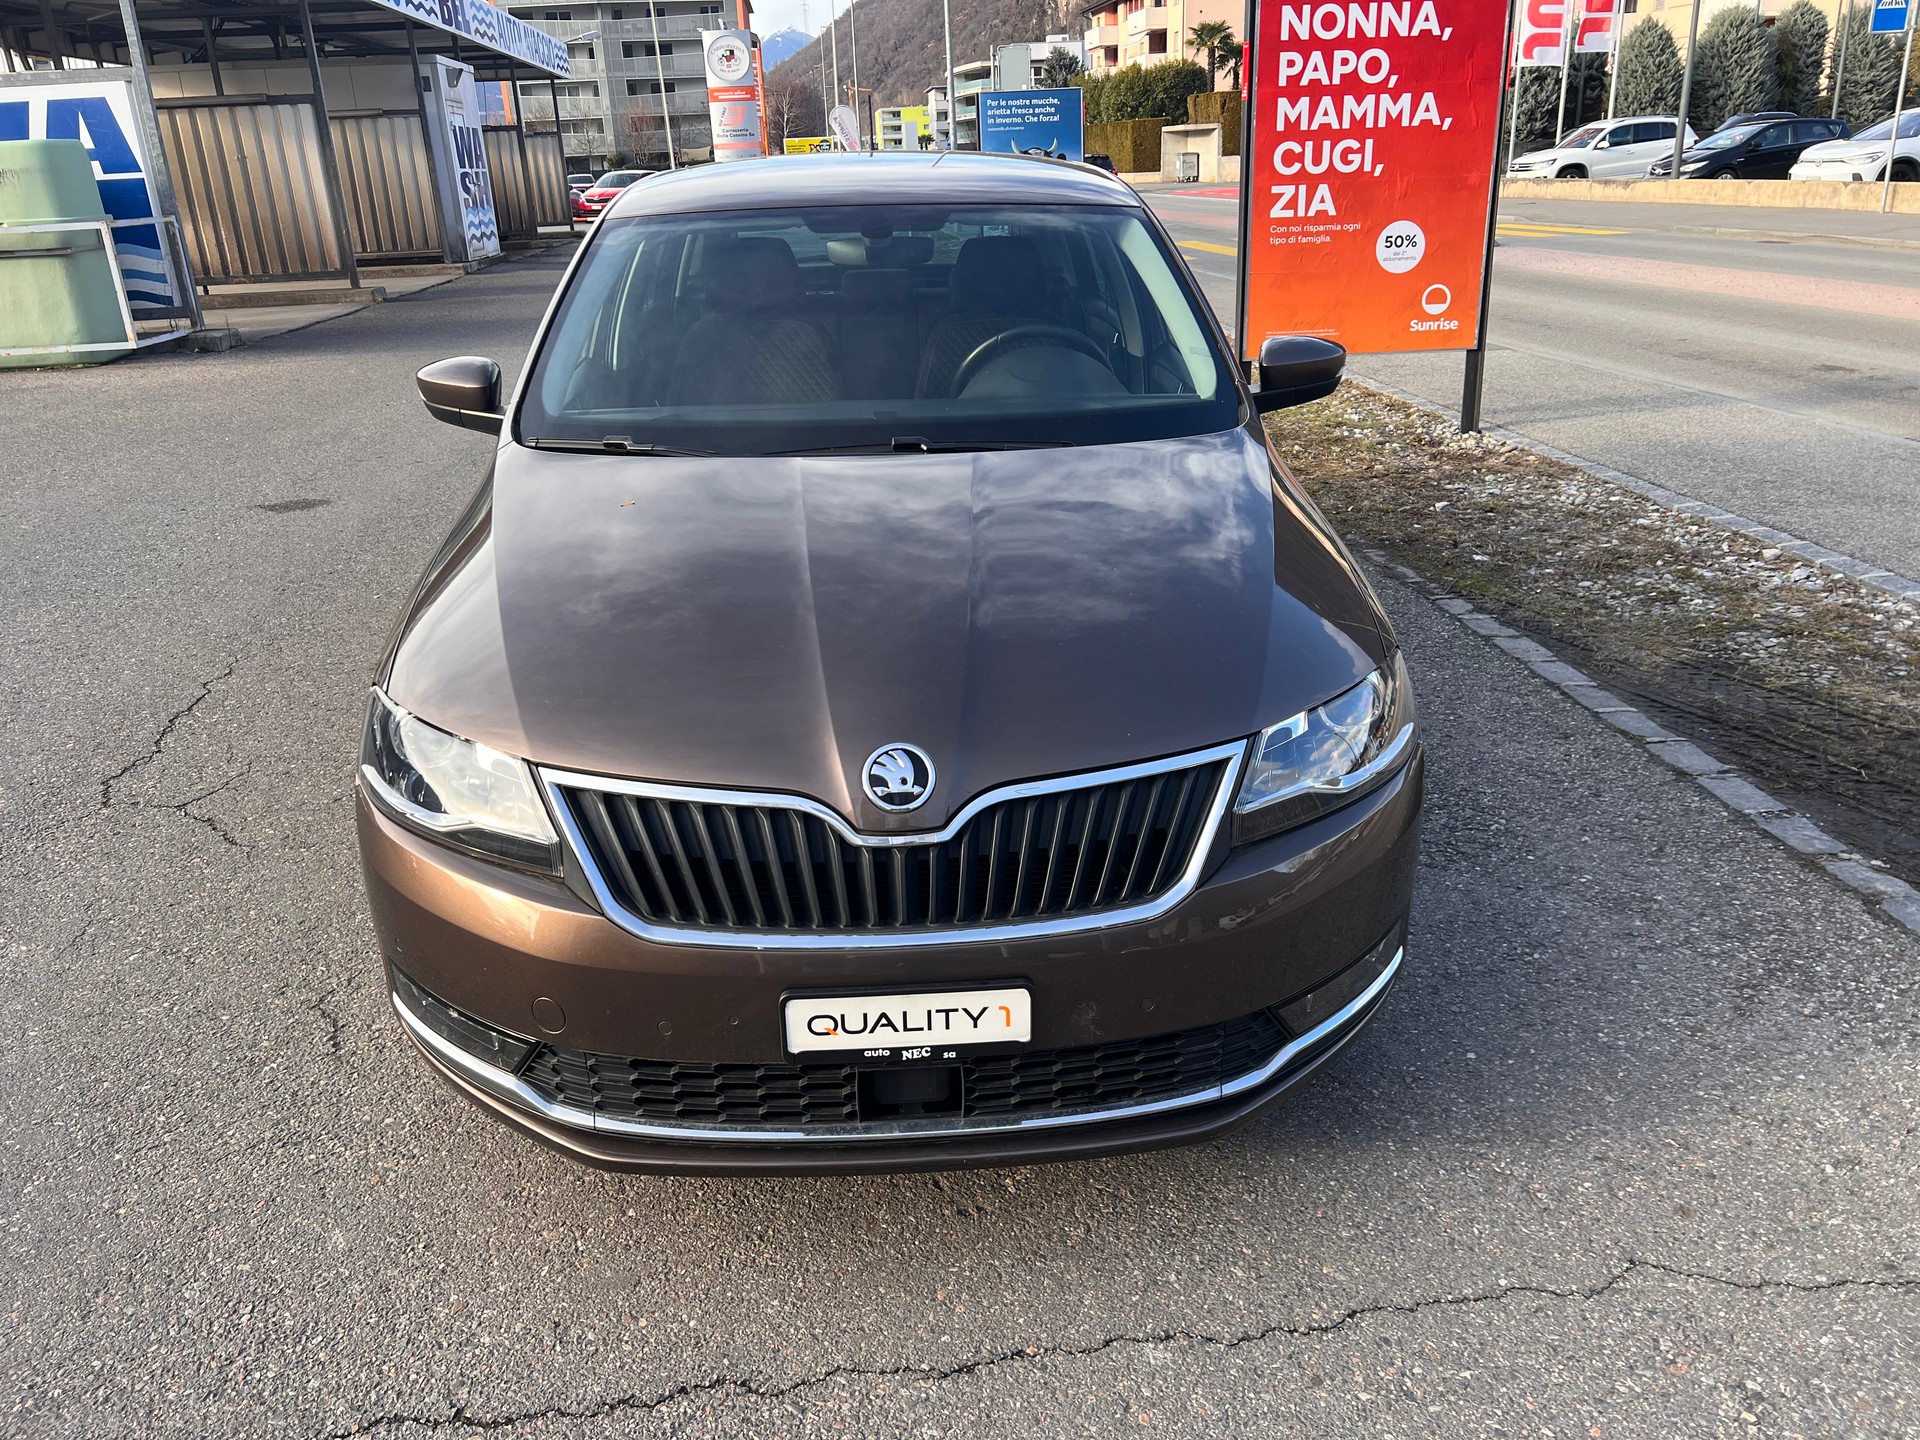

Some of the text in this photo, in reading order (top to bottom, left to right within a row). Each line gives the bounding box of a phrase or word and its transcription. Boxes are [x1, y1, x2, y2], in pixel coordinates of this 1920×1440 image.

[1280, 1, 1453, 41] NONNA,
[1278, 48, 1399, 88] PAPO,
[987, 97, 1060, 107] Per le nostre mucche,
[987, 107, 1010, 115] arietta
[1276, 92, 1453, 131] MAMMA,
[987, 116, 994, 124] in
[995, 116, 1023, 124] inverno.
[1039, 114, 1060, 122] forza!
[1273, 138, 1384, 177] CUGI,
[1269, 183, 1337, 218] ZIA
[1270, 222, 1361, 233] Con noi risparmia ogni
[1269, 234, 1332, 246] tipo di famiglia.
[1384, 234, 1417, 249] 50%
[1409, 317, 1459, 332] Sunrise
[806, 1005, 1011, 1037] QUALITY 1
[863, 1047, 956, 1061] auto NEC sa
